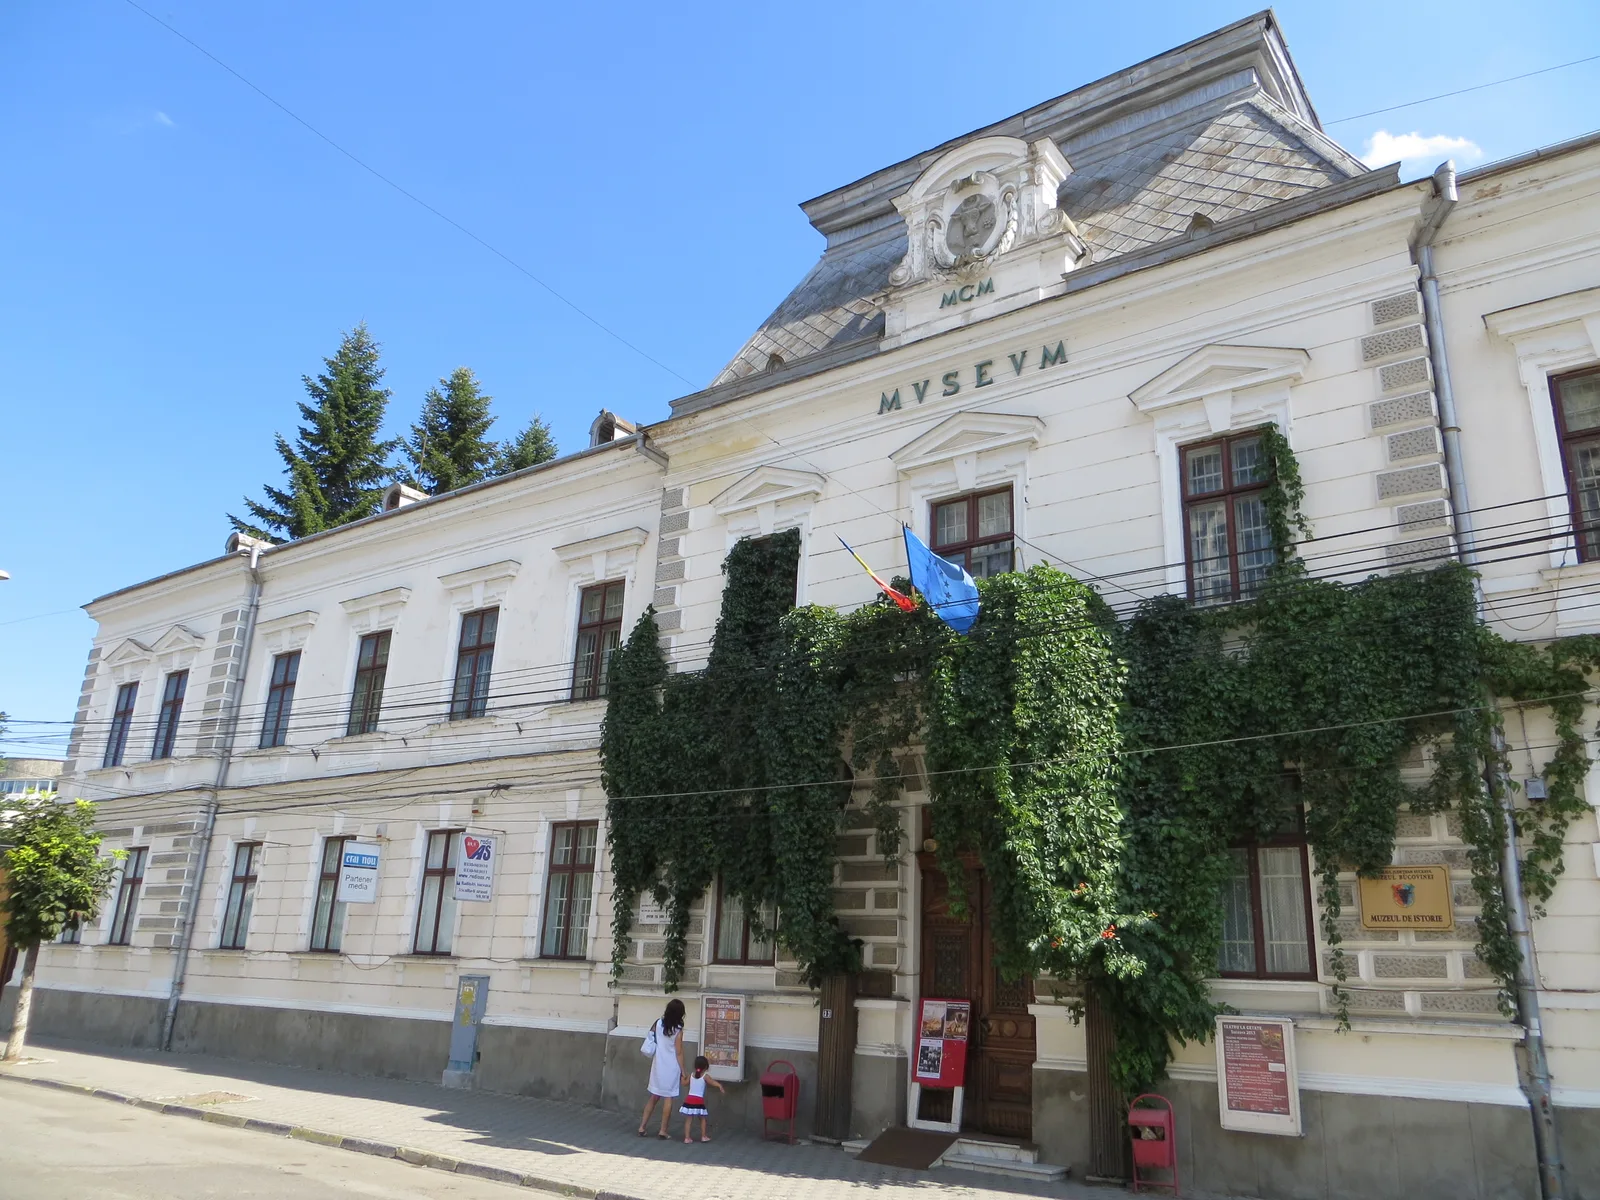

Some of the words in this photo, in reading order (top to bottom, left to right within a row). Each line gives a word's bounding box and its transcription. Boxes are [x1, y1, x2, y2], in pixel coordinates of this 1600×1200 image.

[939, 277, 995, 309] MCM
[877, 340, 1068, 415] MVSEVM
[361, 856, 376, 866] nou
[345, 874, 373, 883] Partener
[1371, 914, 1400, 923] MUZEUL
[1402, 914, 1414, 922] DE
[1414, 914, 1443, 923] ISTORIE
